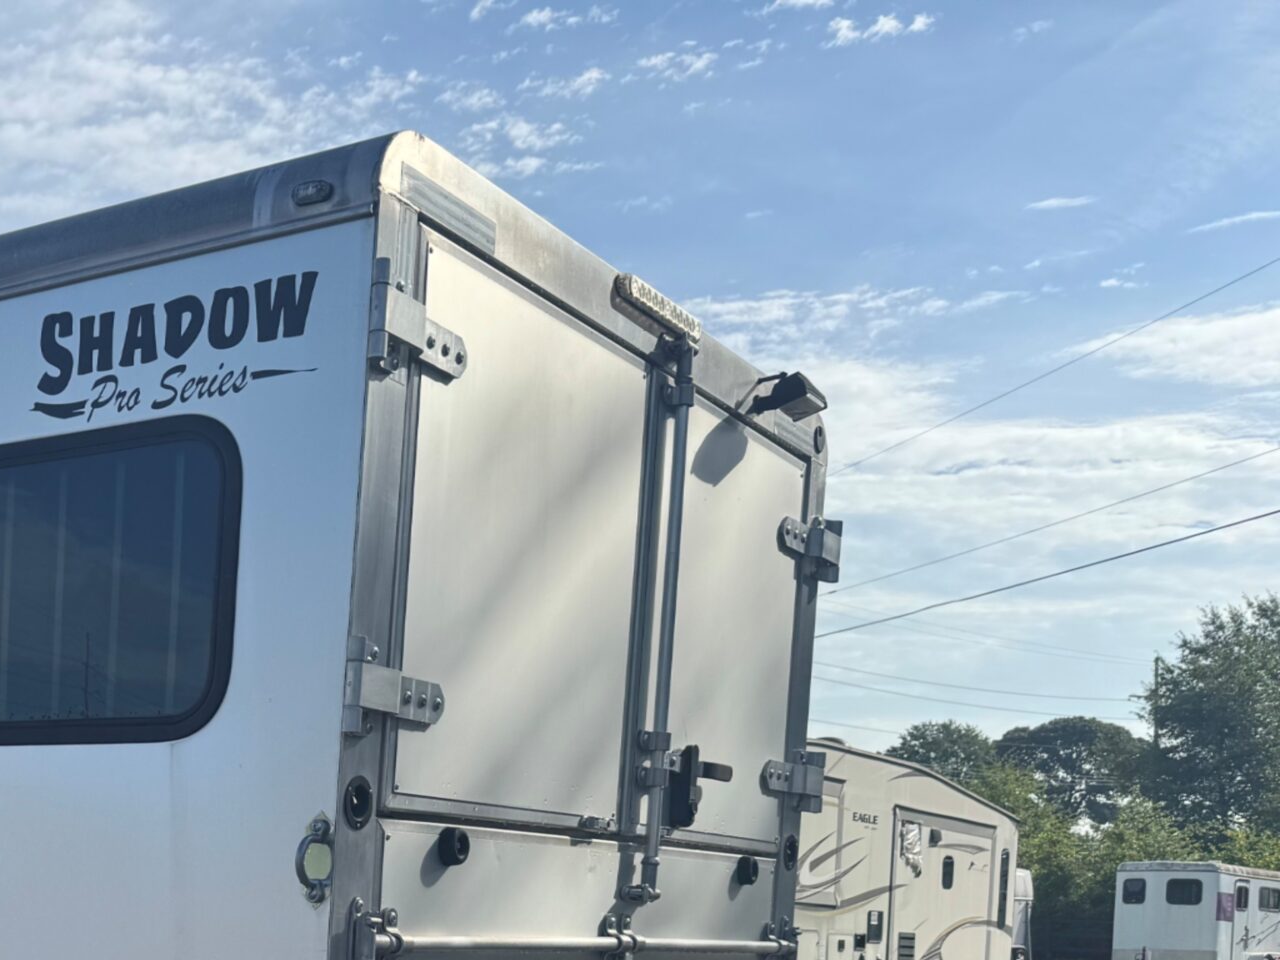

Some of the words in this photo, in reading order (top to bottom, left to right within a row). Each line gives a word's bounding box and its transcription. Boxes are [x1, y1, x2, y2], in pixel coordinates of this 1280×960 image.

[36, 270, 320, 396] SHADOW
[86, 374, 141, 423] Pro
[150, 362, 249, 410] Series
[852, 811, 879, 825] EAGLE
